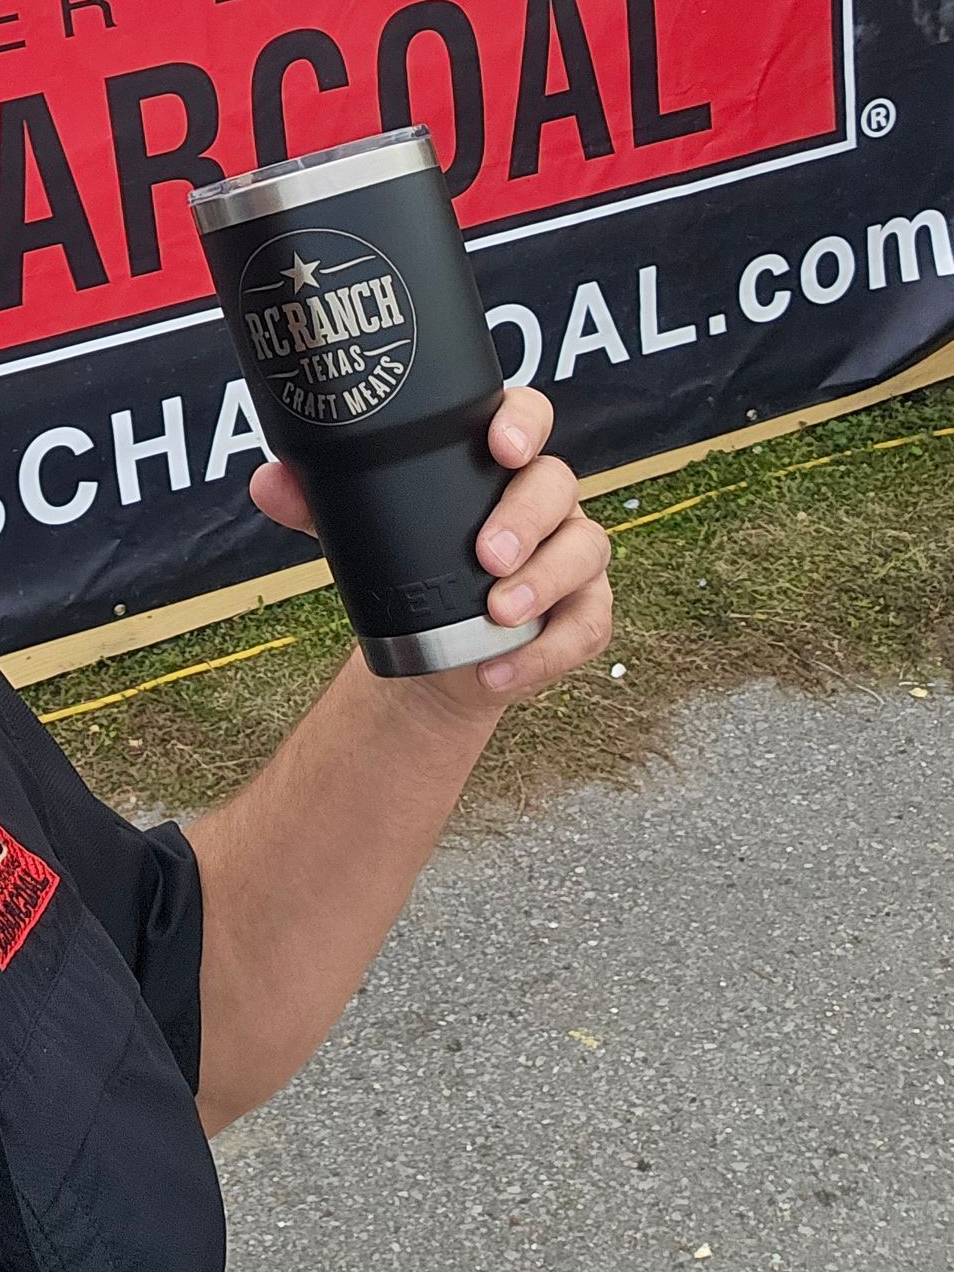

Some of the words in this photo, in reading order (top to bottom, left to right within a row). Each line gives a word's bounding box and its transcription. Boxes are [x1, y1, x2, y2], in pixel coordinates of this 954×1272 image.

[281, 274, 405, 353] RANCH
[281, 381, 339, 420] CRAFT
[342, 355, 405, 416] MEATS
[300, 344, 366, 384] TEXAS
